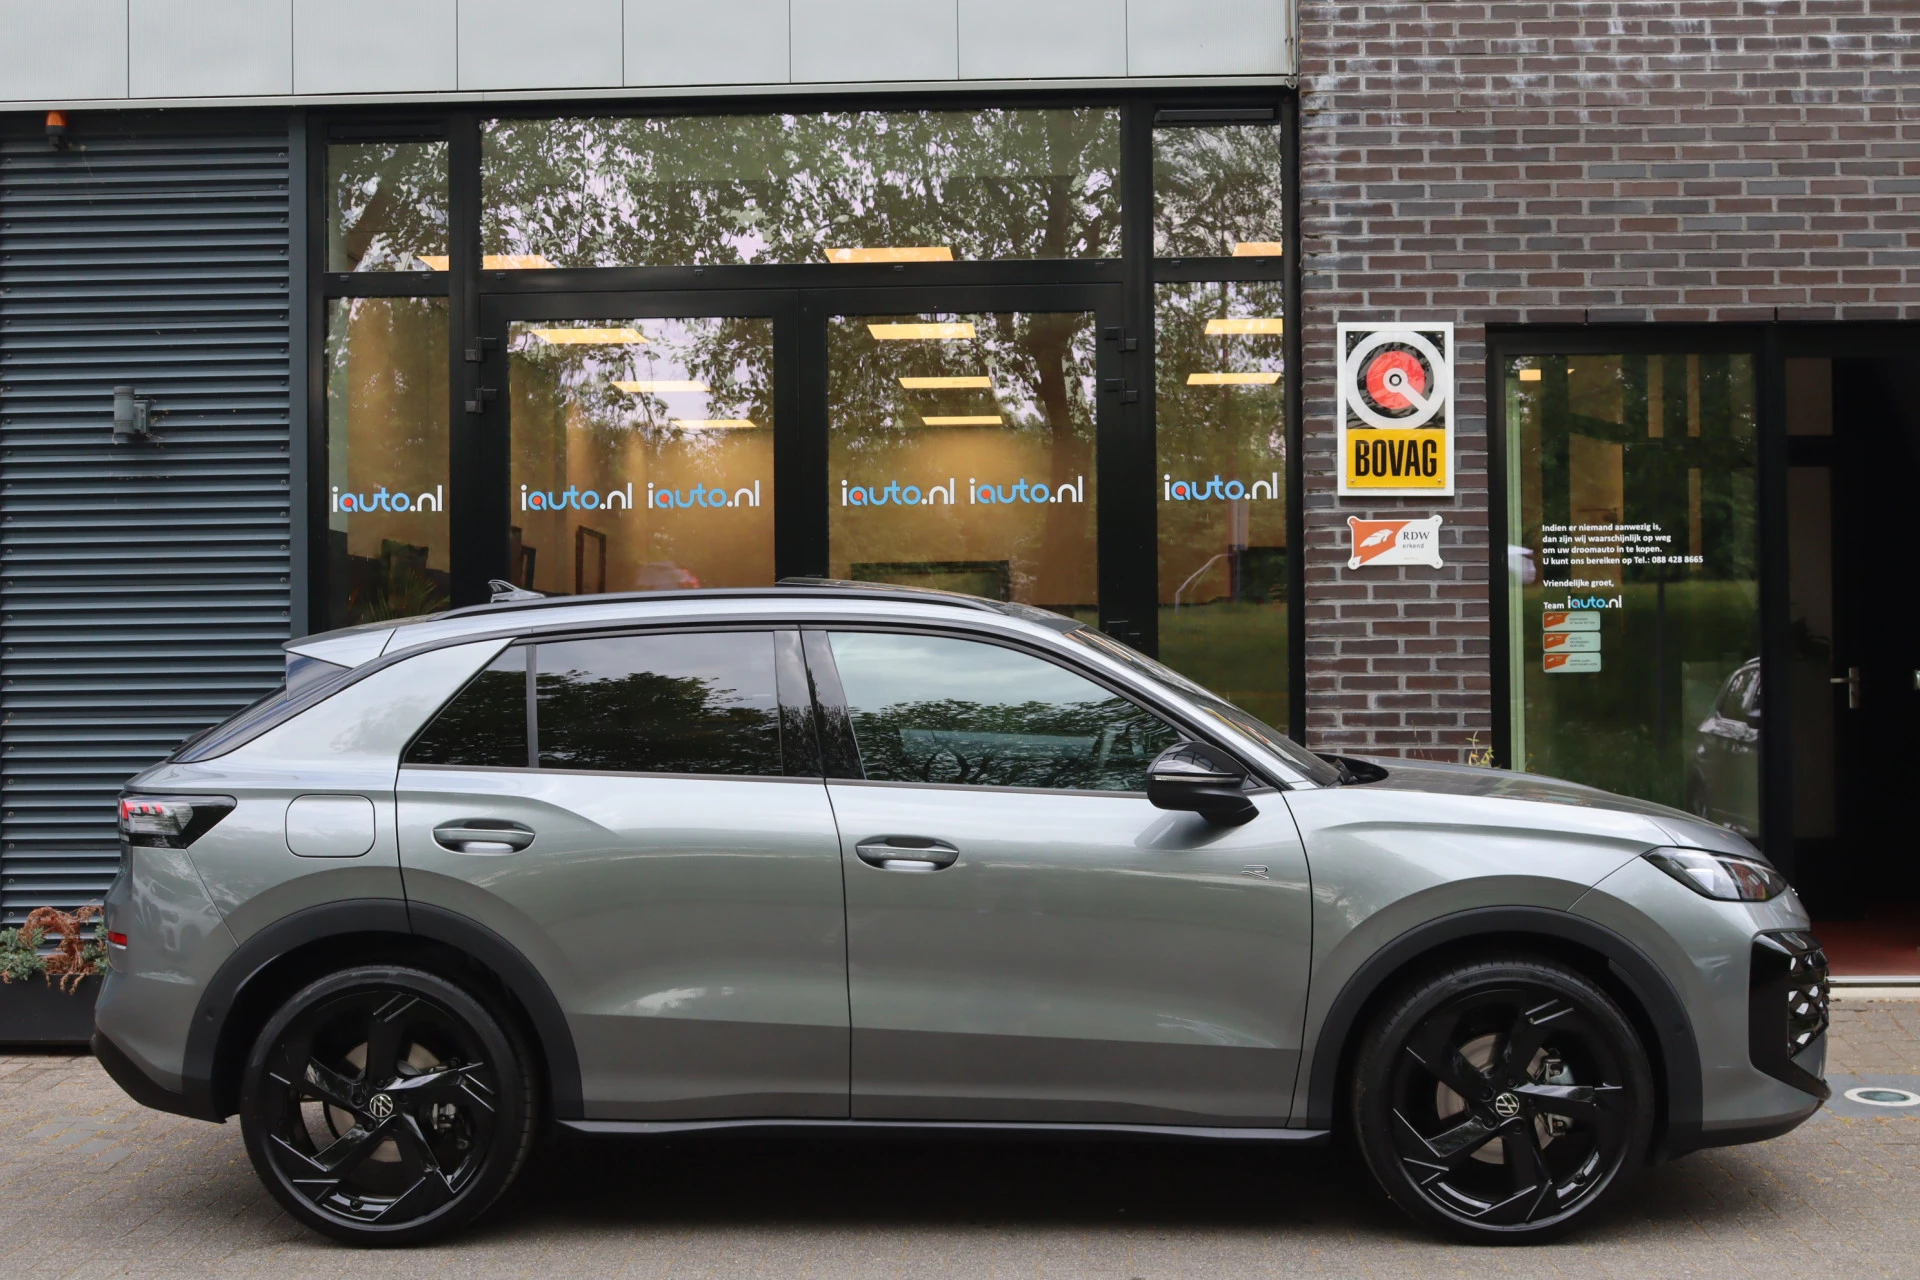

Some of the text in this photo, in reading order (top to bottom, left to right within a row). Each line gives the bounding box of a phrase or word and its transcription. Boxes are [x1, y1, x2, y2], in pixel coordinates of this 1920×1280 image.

[1354, 438, 1438, 478] BOVAG
[841, 475, 1083, 507] iauto.nl iauto.nl
[1164, 472, 1279, 502] iauto.nl
[331, 484, 444, 513] iauto.nl
[521, 479, 760, 511] iauto.nl iauto.nl
[1542, 524, 1567, 532] Indien
[1578, 523, 1613, 531] niemand
[1614, 522, 1651, 532] aanwezig
[1652, 522, 1662, 532] is,
[1403, 531, 1431, 540] RDW
[1542, 533, 1672, 544] dan zijn wij waarschijnlijk op weg
[1571, 546, 1615, 554] droomauto
[1616, 545, 1624, 553] in
[1635, 544, 1663, 554] kopen.
[1542, 557, 1549, 565] U
[1550, 557, 1569, 565] kunt
[1586, 556, 1620, 565] bereiken
[1621, 557, 1633, 566] op
[1633, 556, 1650, 564] Tel.:
[1651, 555, 1667, 564] 088
[1667, 555, 1683, 564] 428
[1683, 555, 1704, 563] 8665
[1542, 579, 1615, 588] Vriendelijke groet,
[1543, 595, 1623, 610] Team iauto.nl
